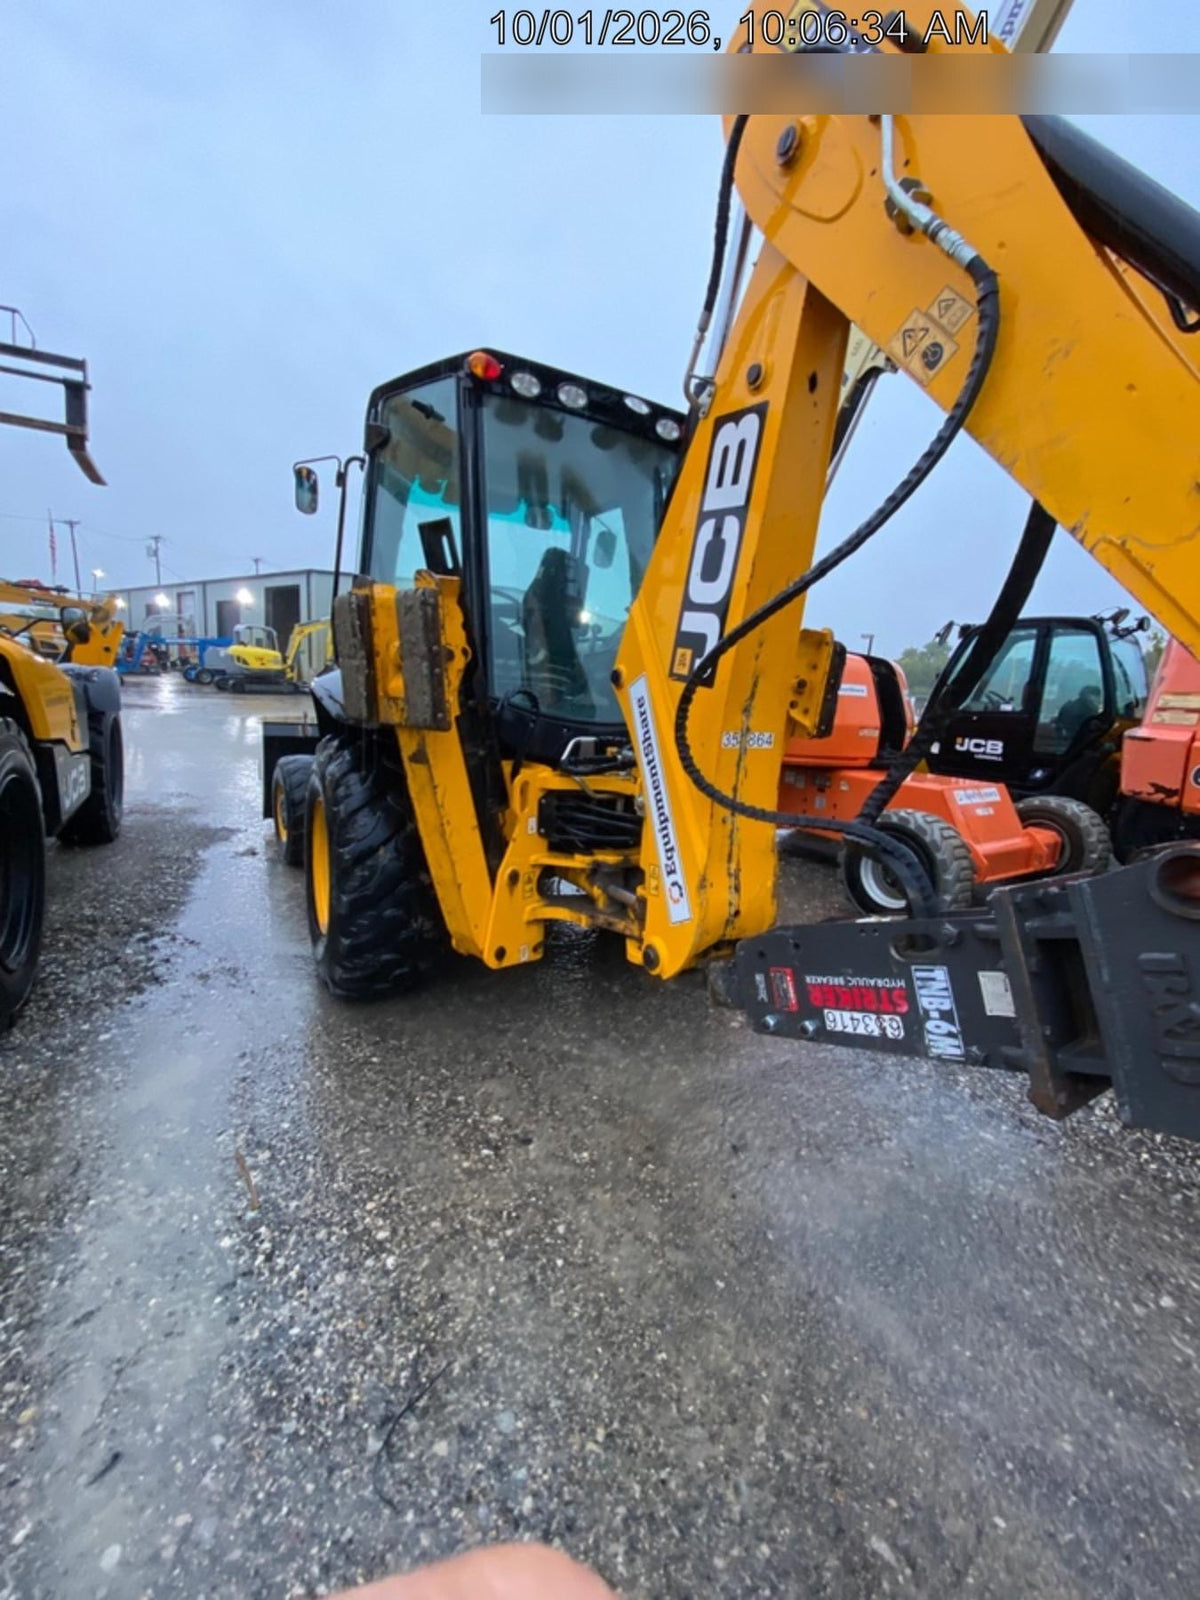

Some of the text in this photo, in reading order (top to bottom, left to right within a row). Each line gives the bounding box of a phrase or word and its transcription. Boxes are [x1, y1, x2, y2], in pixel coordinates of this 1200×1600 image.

[681, 412, 760, 678] JCB
[955, 737, 1003, 755] JCB
[636, 695, 677, 877] EquipmentShare
[804, 975, 906, 989] HYDRAULIC BREAKER
[806, 985, 909, 1014] STRIKER
